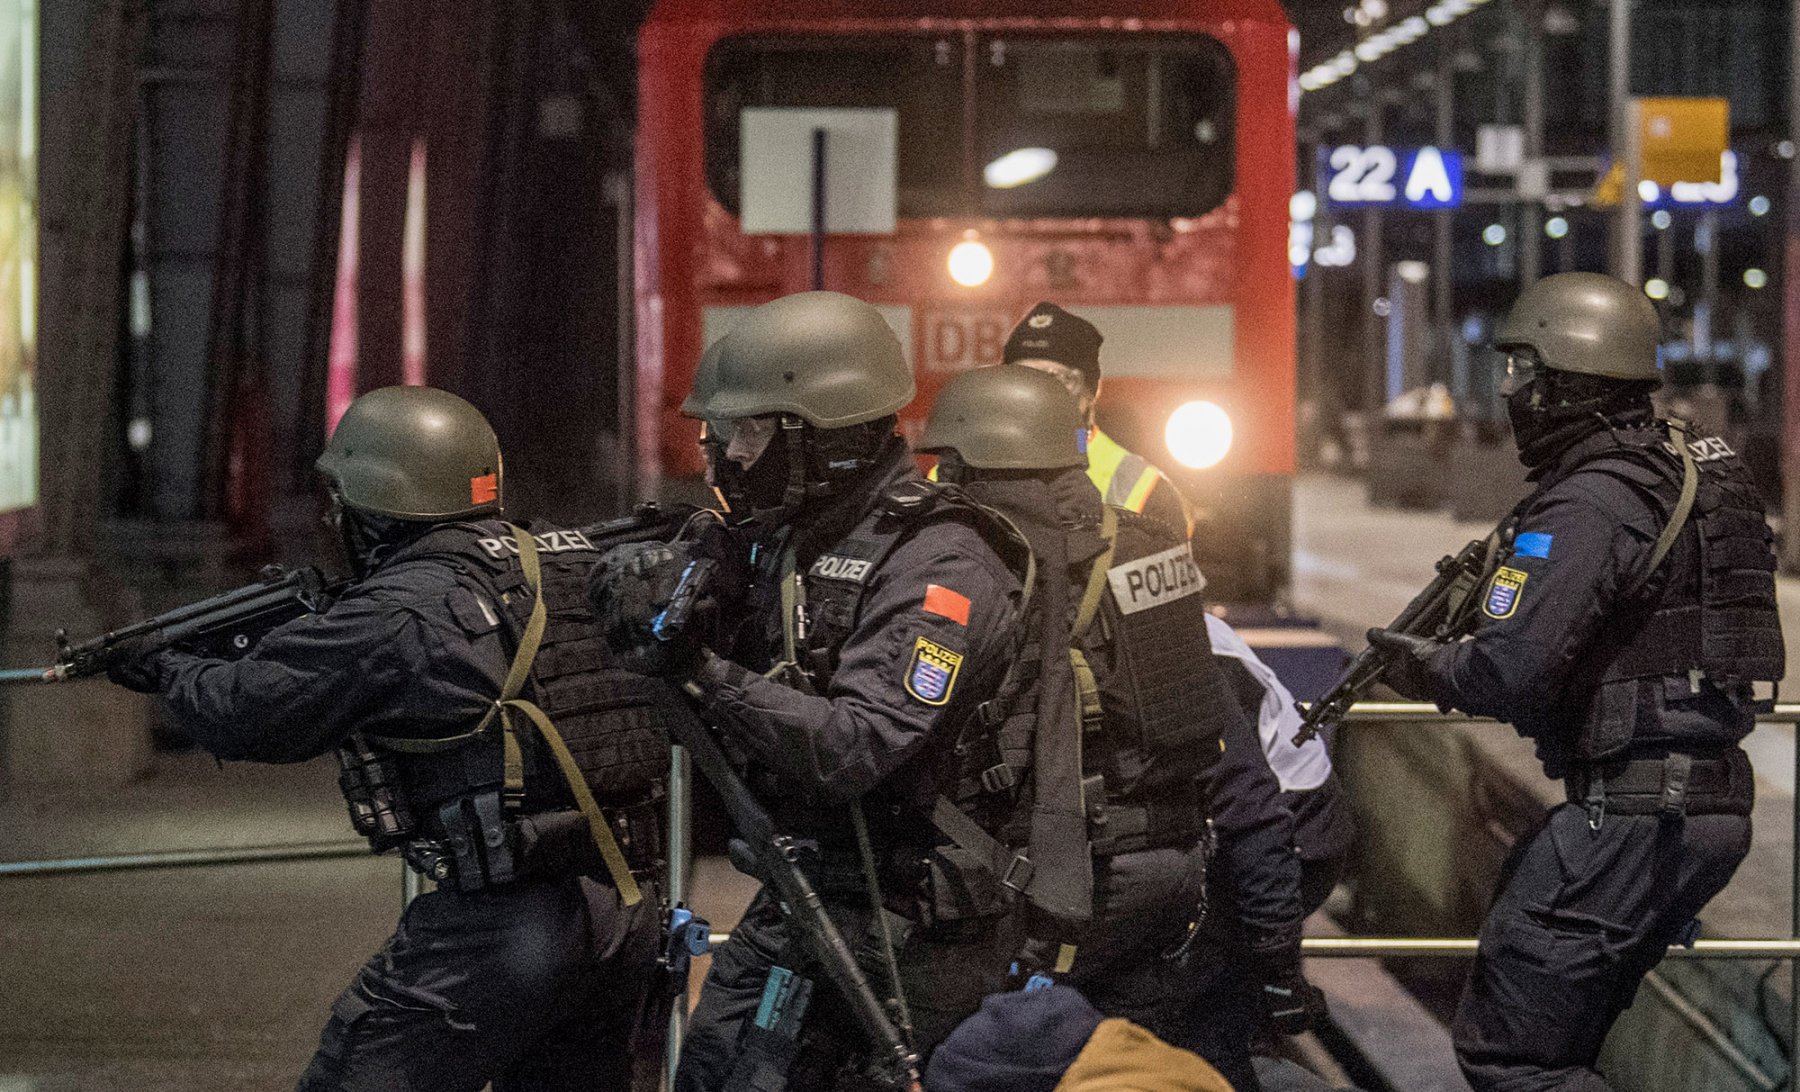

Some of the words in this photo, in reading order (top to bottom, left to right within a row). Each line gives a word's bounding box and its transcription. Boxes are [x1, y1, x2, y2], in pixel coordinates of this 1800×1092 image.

[1329, 145, 1397, 201] 22
[1405, 146, 1453, 202] A
[808, 555, 873, 581] POLIZEI
